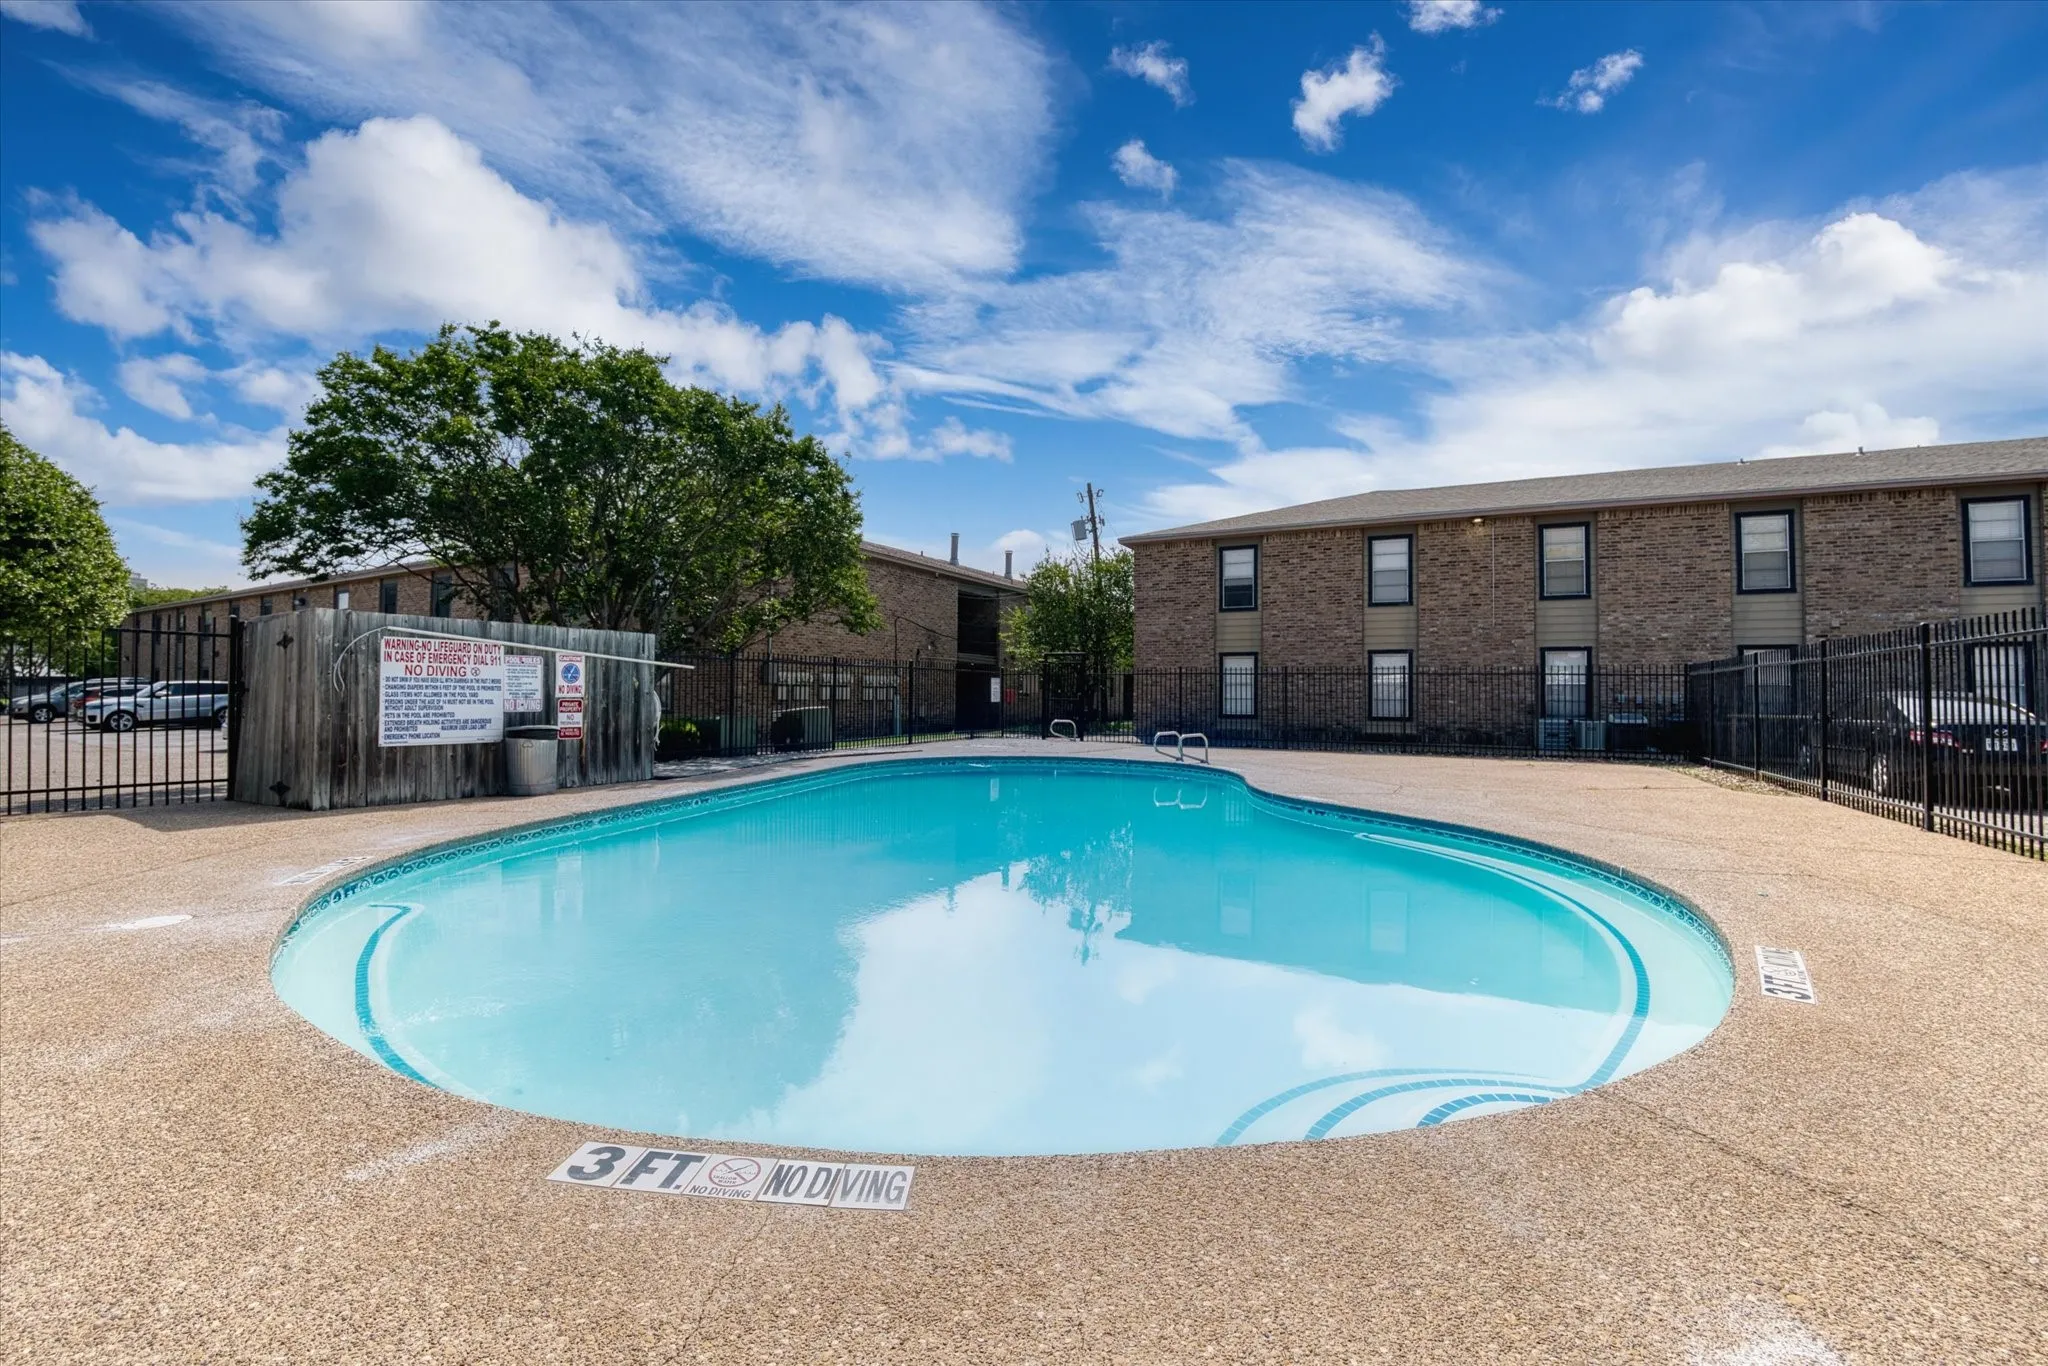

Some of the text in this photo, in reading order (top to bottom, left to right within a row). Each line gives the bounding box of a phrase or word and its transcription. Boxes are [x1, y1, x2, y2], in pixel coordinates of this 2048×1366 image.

[434, 641, 471, 653] LIFEGUARD
[473, 643, 483, 654] ON
[485, 644, 502, 655] DUTY
[384, 651, 501, 666] IN CASE OF EMERGENCY DIAL 911
[405, 665, 467, 677] NO DIVING
[567, 1146, 626, 1181] 3
[762, 1164, 907, 1204] NO DIVING
[689, 1185, 751, 1198] NO DIVING
